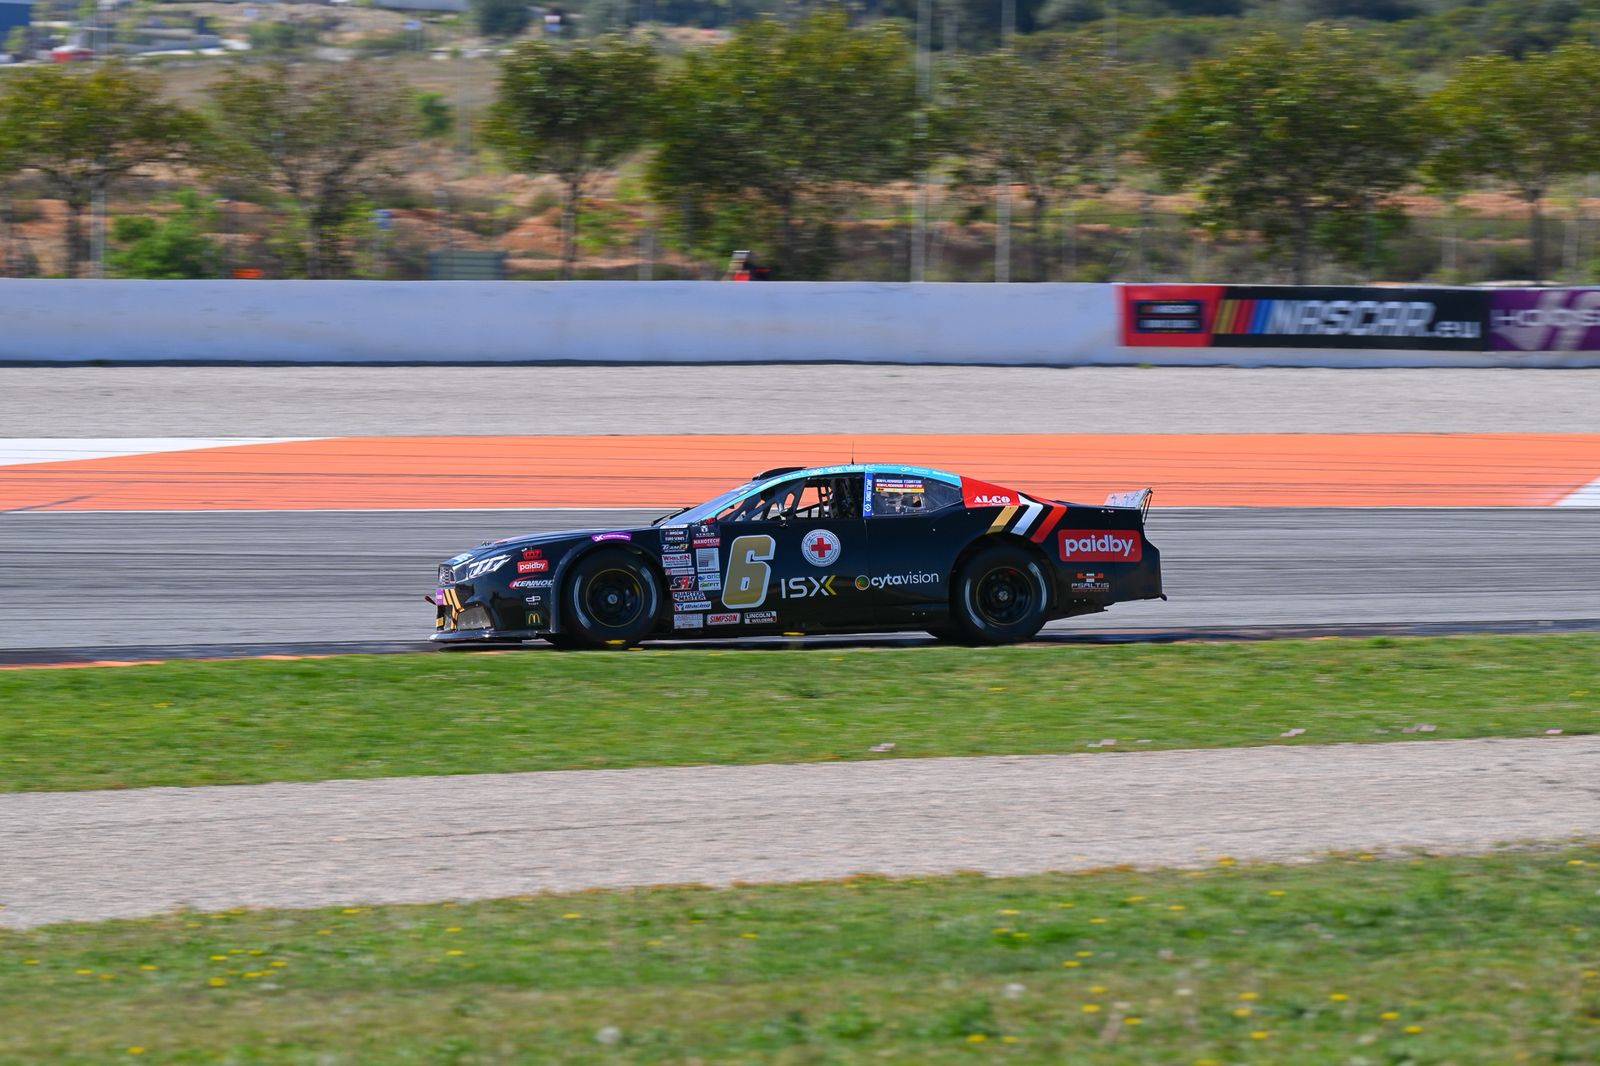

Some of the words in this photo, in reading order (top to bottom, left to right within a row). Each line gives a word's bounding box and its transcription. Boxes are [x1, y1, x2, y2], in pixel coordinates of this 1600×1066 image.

[974, 495, 1011, 504] ALCO
[1065, 534, 1134, 557] paidby
[519, 562, 545, 571] paidby
[721, 534, 776, 610] 6
[871, 570, 940, 589] cytavision
[709, 615, 737, 623] SIMPSON
